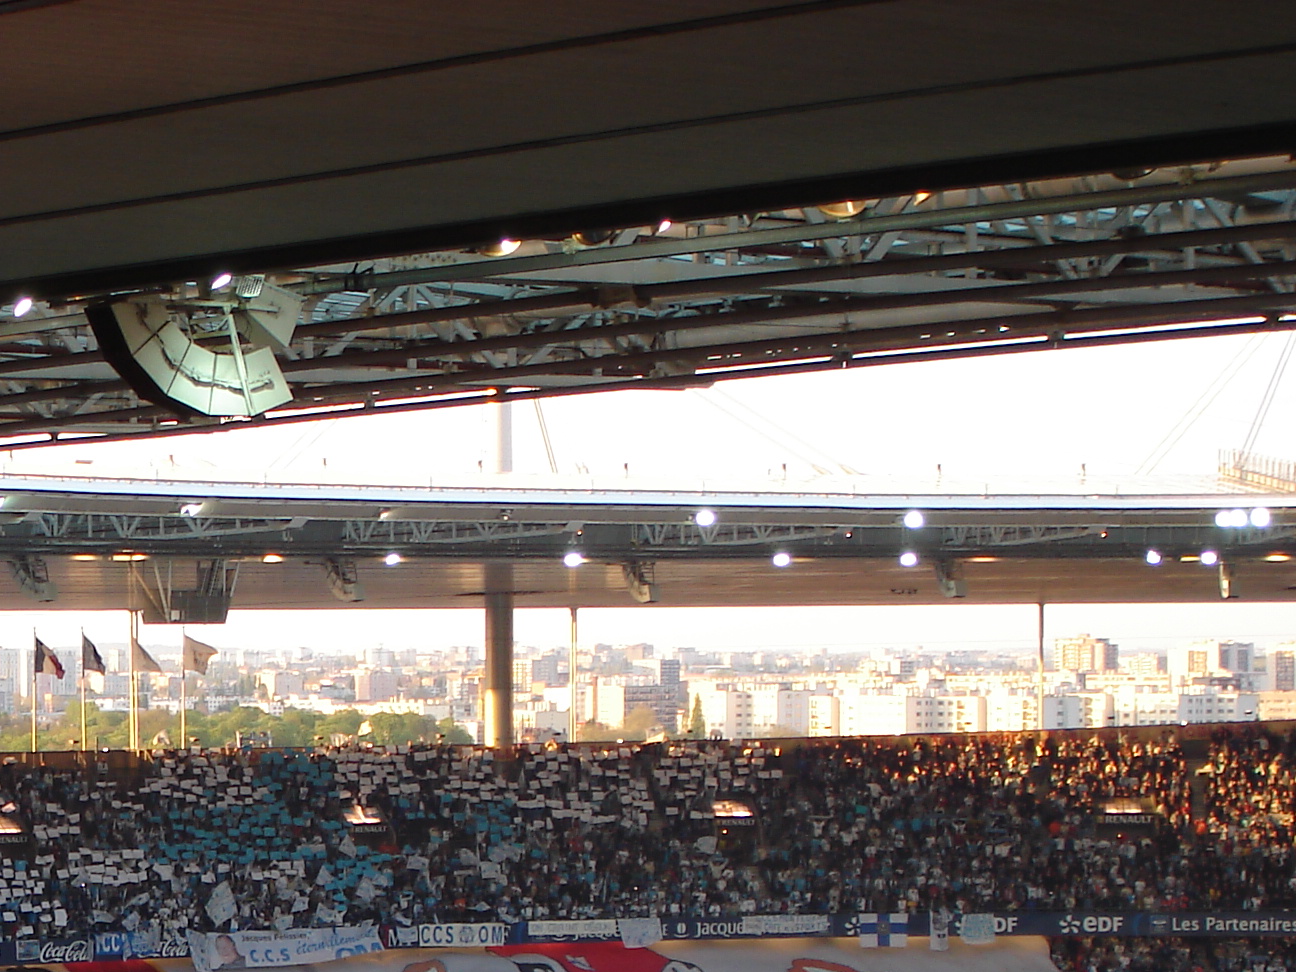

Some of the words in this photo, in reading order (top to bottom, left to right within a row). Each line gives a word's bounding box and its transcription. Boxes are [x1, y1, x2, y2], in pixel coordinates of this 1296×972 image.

[1172, 917, 1199, 931] Les
[1206, 916, 1296, 932] Partenaires
[421, 926, 454, 943] CCS
